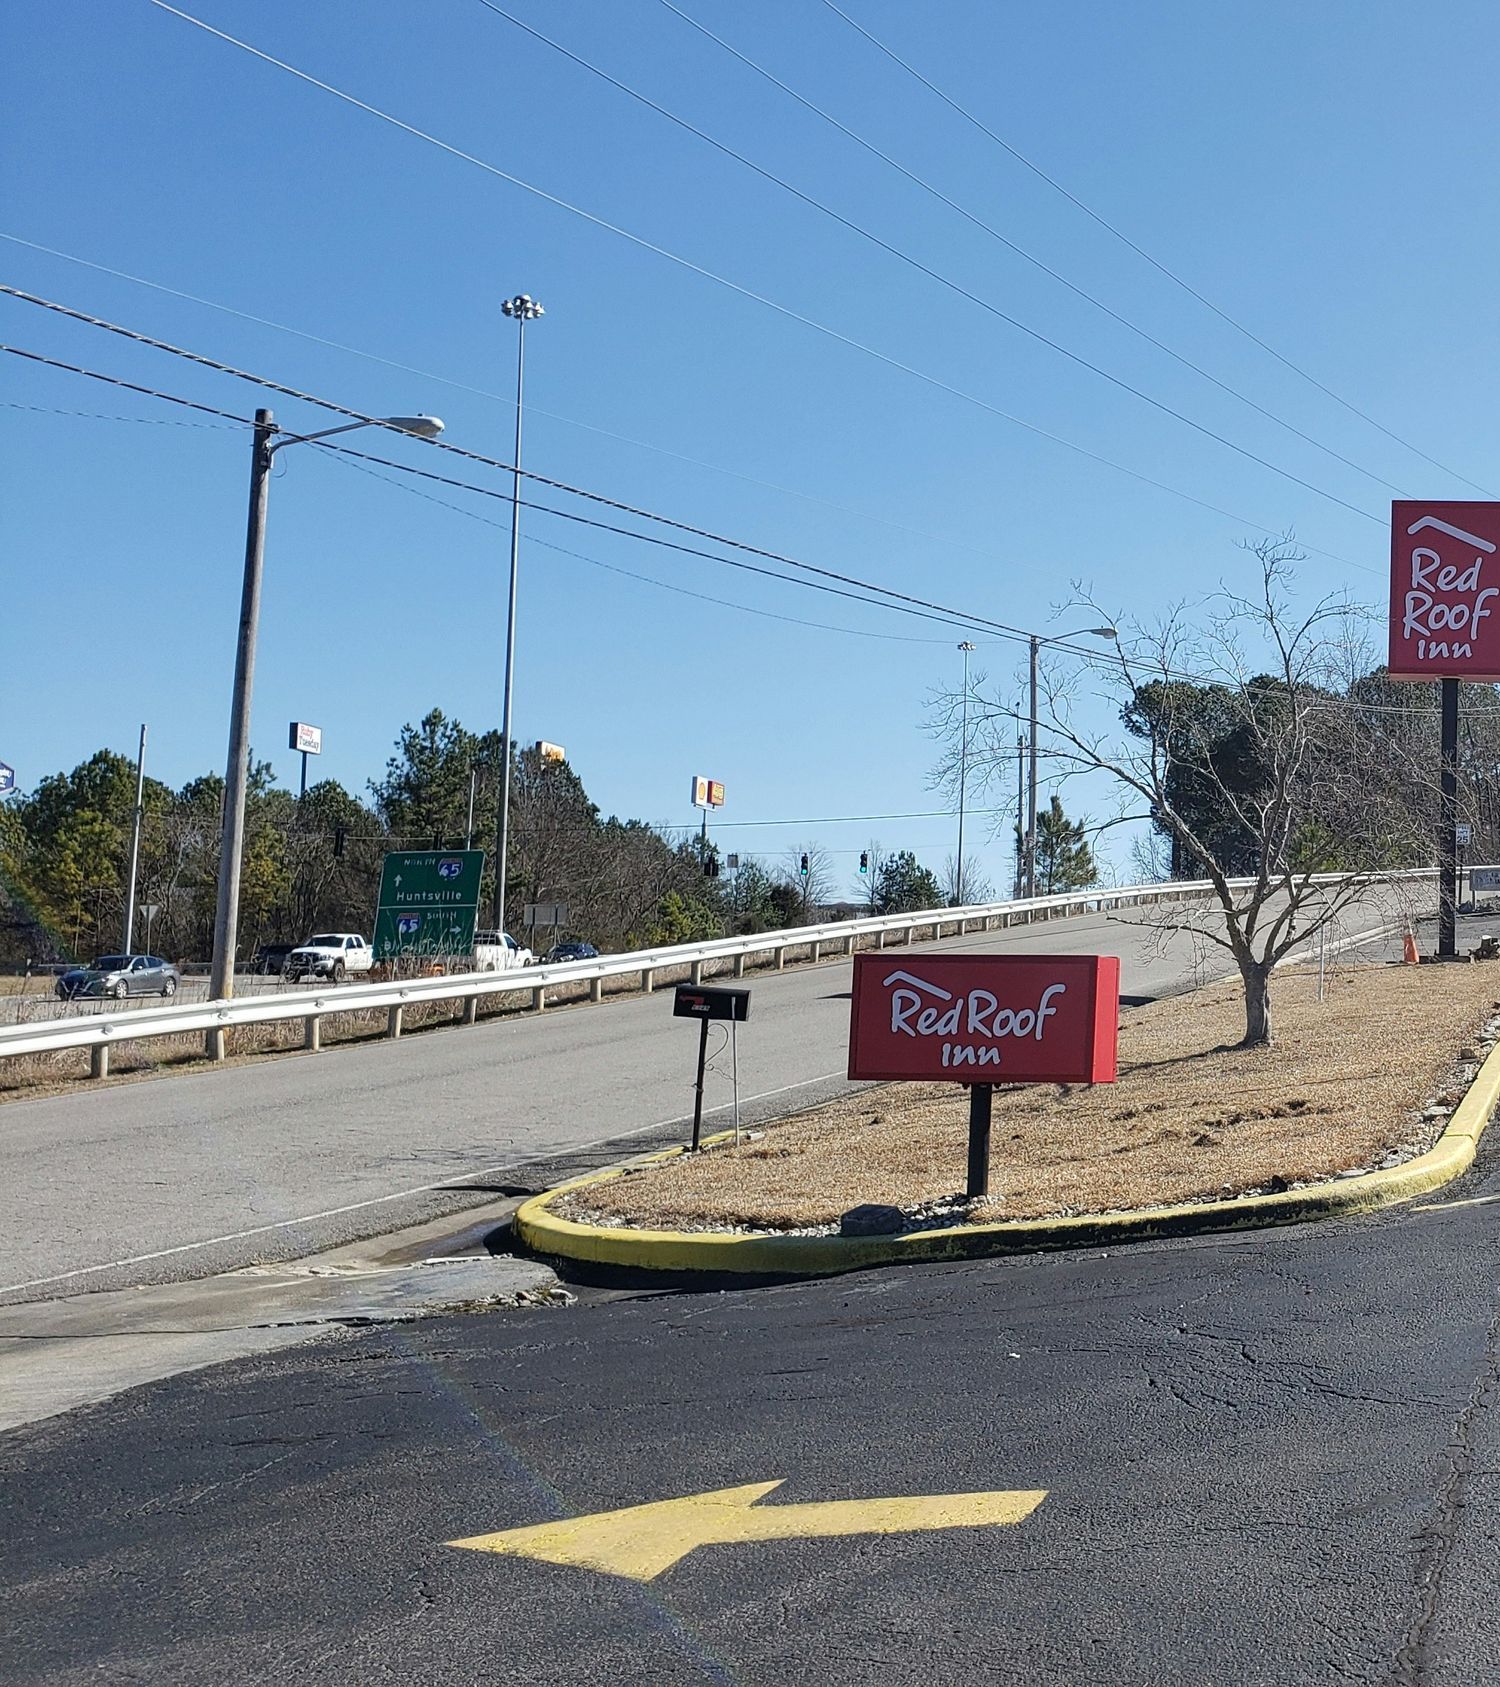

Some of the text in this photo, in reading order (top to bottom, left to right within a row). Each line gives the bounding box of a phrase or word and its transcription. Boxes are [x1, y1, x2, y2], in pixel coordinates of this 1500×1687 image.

[1411, 547, 1482, 593] Red
[1403, 587, 1500, 641] Roof
[1456, 835, 1469, 844] 25
[439, 863, 460, 877] 65
[396, 890, 462, 901] Huntsville
[400, 919, 418, 934] 65
[891, 983, 1066, 1041] Red Roof
